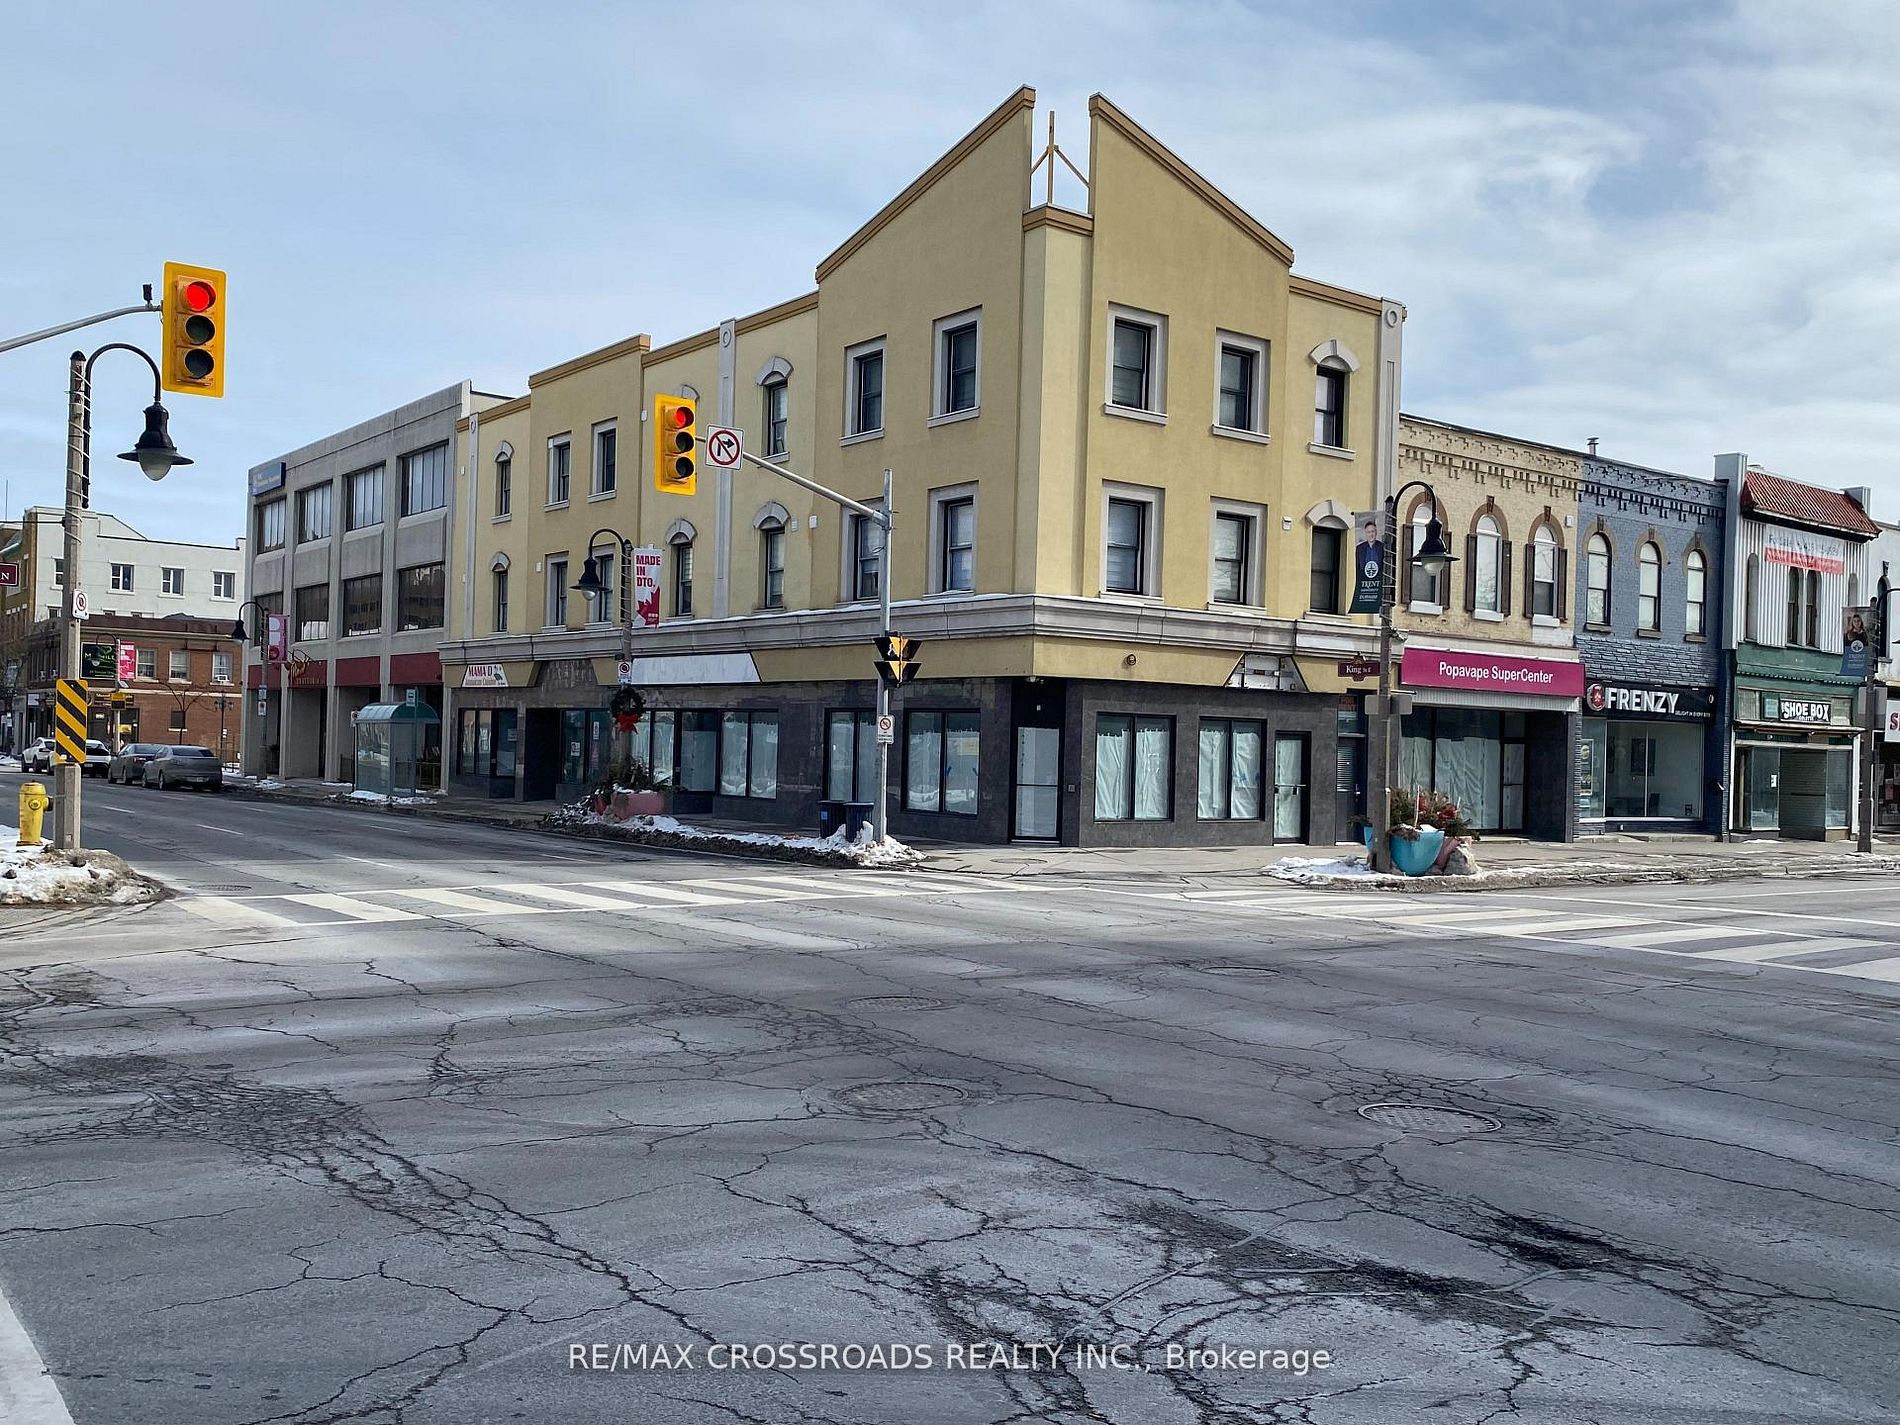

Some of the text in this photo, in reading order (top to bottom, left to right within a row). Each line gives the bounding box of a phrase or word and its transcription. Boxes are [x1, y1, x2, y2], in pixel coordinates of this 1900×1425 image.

[635, 554, 661, 566] MADE
[1, 572, 10, 580] N
[636, 566, 646, 576] IN
[637, 577, 655, 587] DTO.
[1361, 581, 1380, 589] TRENT
[468, 665, 487, 677] MAMA
[1346, 665, 1362, 674] King
[1439, 661, 1554, 683] Popavape SuperCenter
[1605, 687, 1680, 714] FRENZY
[1783, 701, 1809, 719] SHOE
[1810, 703, 1830, 722] BOX
[1889, 712, 1900, 731] S
